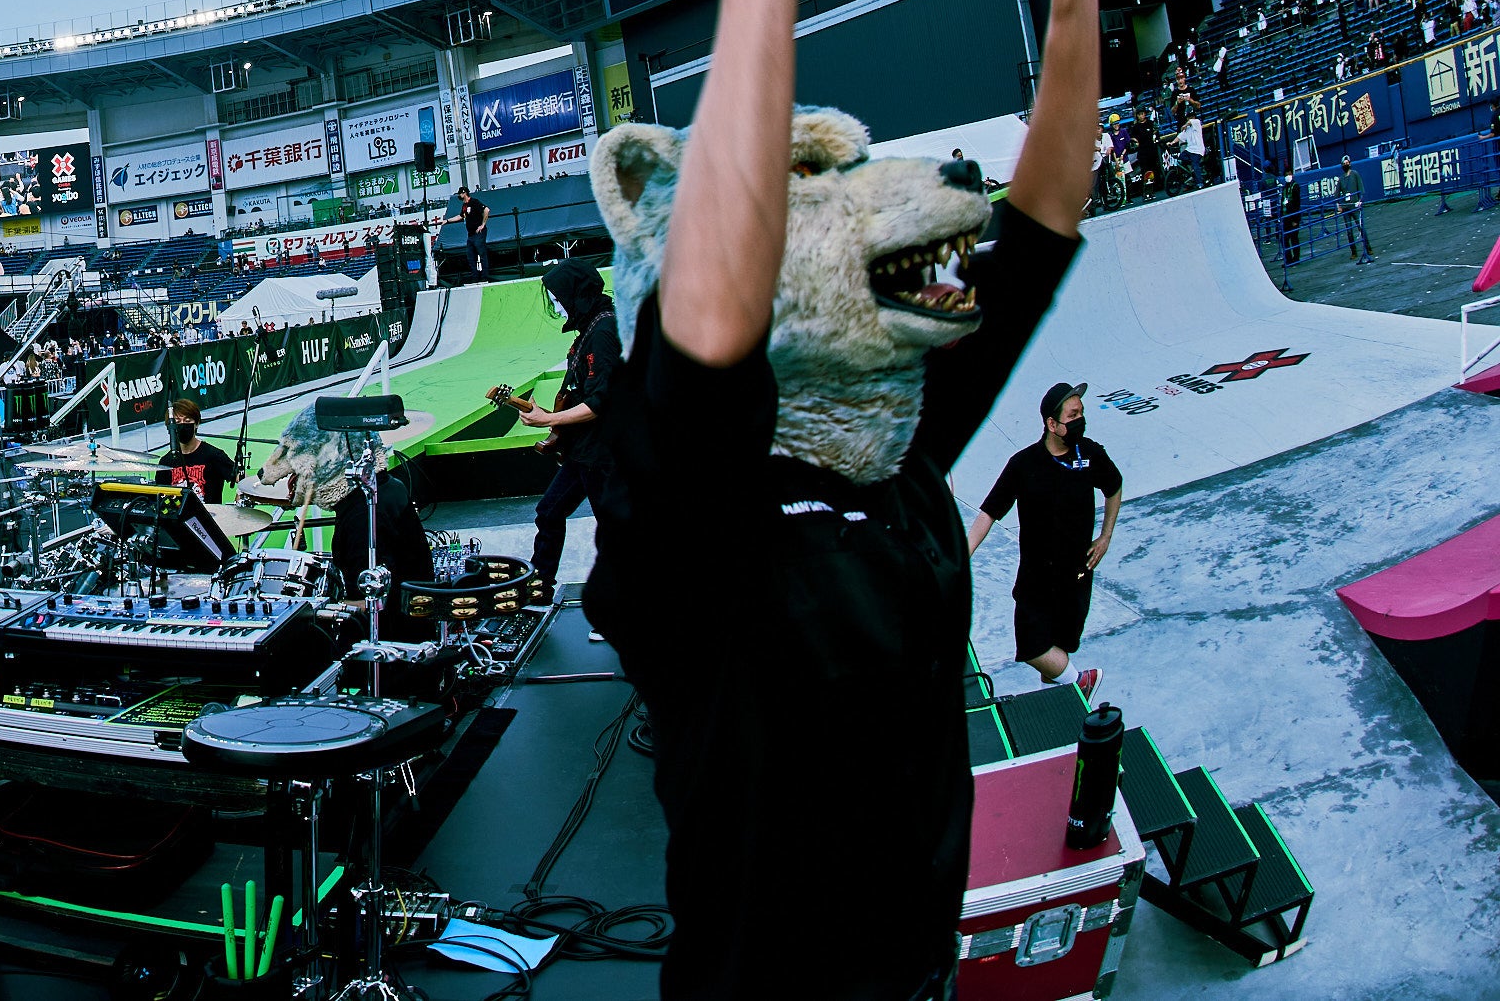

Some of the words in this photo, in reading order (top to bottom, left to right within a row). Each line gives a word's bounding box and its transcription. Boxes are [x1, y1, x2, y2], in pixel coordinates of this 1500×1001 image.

[511, 91, 574, 124] 京葉銀行
[579, 83, 594, 127] 大森工業
[349, 113, 409, 129] アイデアとテクノロジーで
[481, 128, 502, 140] BANK
[137, 155, 201, 170] 人材の総合プロデュース企業
[245, 138, 322, 170] 千葉銀行
[491, 154, 530, 175] KOITO
[51, 174, 77, 183] GAMES
[134, 164, 206, 186] エイジェック
[359, 177, 384, 187] そらまめ
[52, 191, 78, 203] yogibo
[249, 198, 270, 206] KAKUTA
[301, 338, 329, 365] HUF
[183, 356, 225, 390] yogibo
[118, 373, 163, 401] GAMES
[1167, 373, 1224, 395] GAMES
[1097, 388, 1160, 415] yogibo
[362, 416, 383, 424] Roland
[191, 521, 207, 541] Roland
